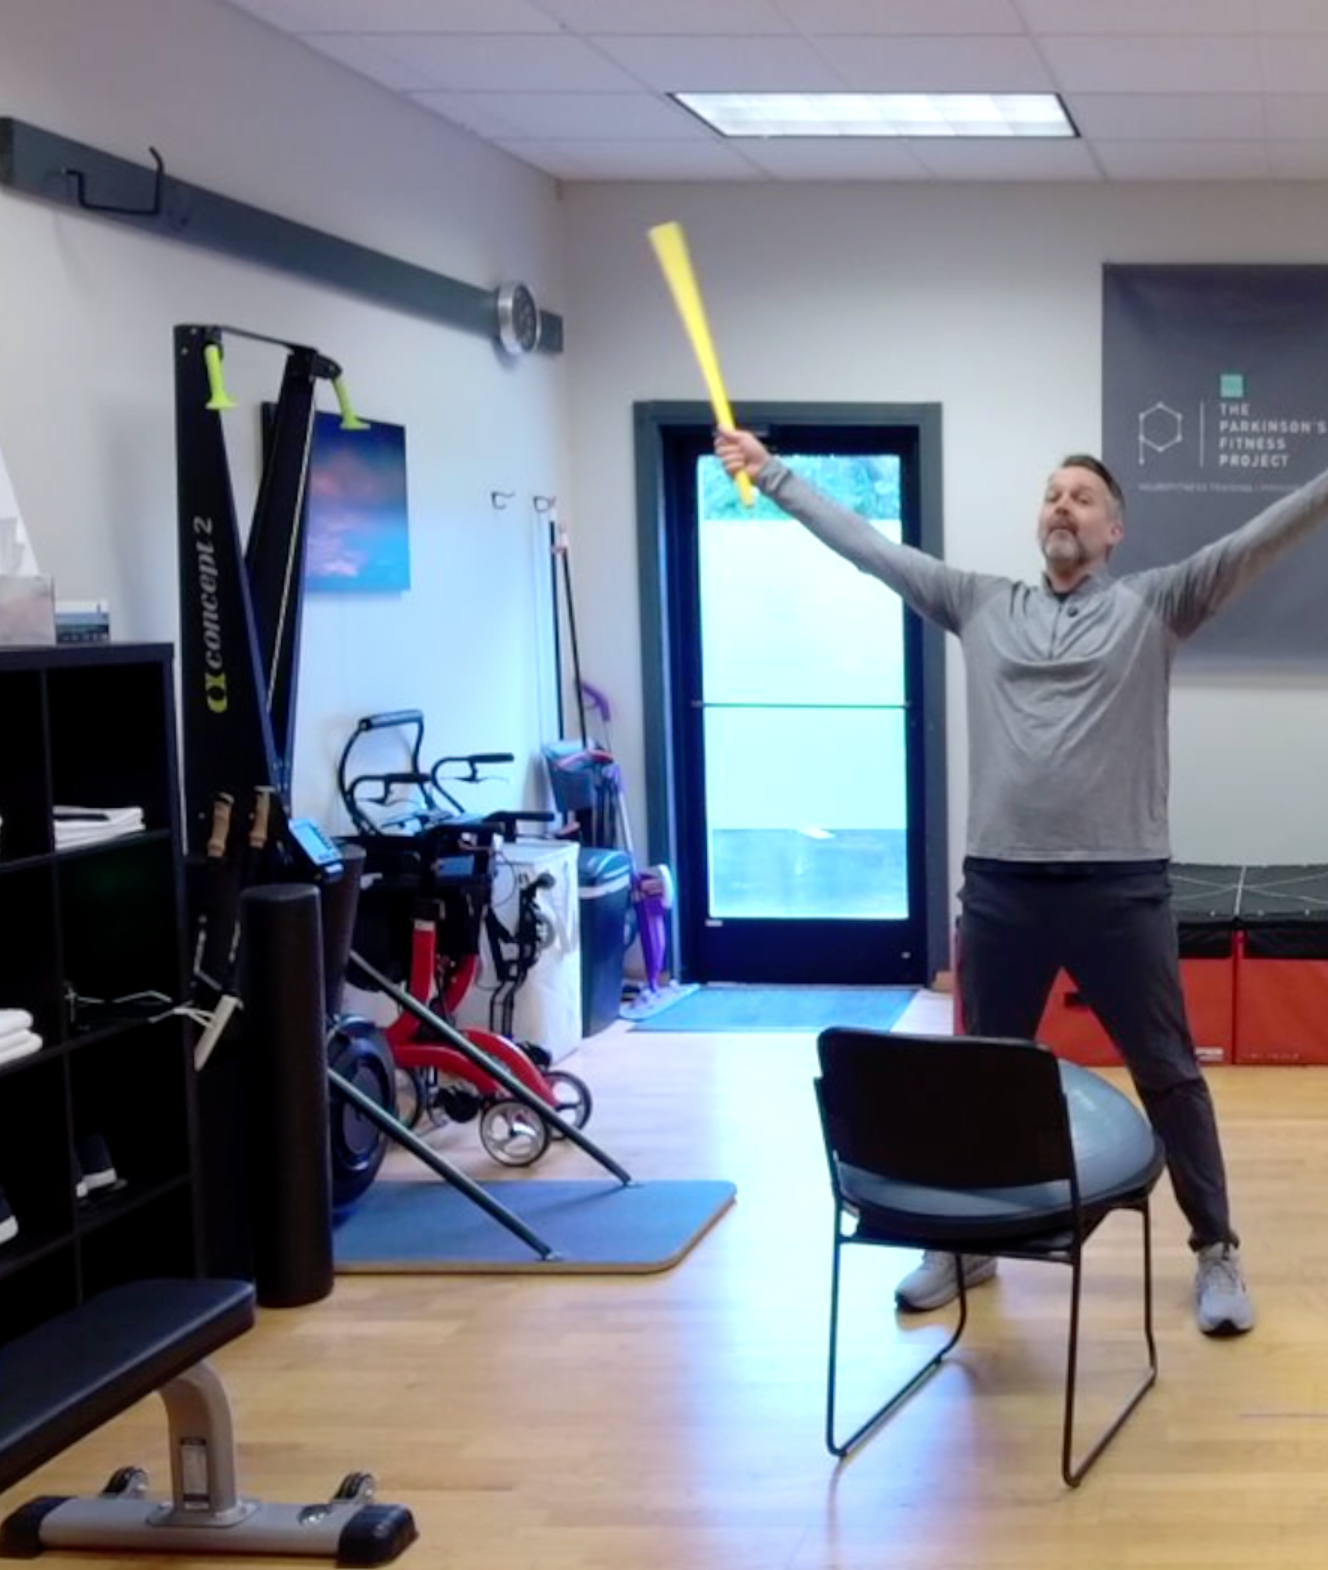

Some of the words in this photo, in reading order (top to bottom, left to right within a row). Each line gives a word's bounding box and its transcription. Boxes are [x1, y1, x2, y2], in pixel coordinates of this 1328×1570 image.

[1219, 403, 1249, 416] THE
[1219, 420, 1328, 433] PARKINSON'S
[1219, 437, 1287, 450] FITNESS
[1219, 454, 1290, 467] PROJECT
[193, 515, 213, 535] 2
[196, 541, 222, 670] concept
